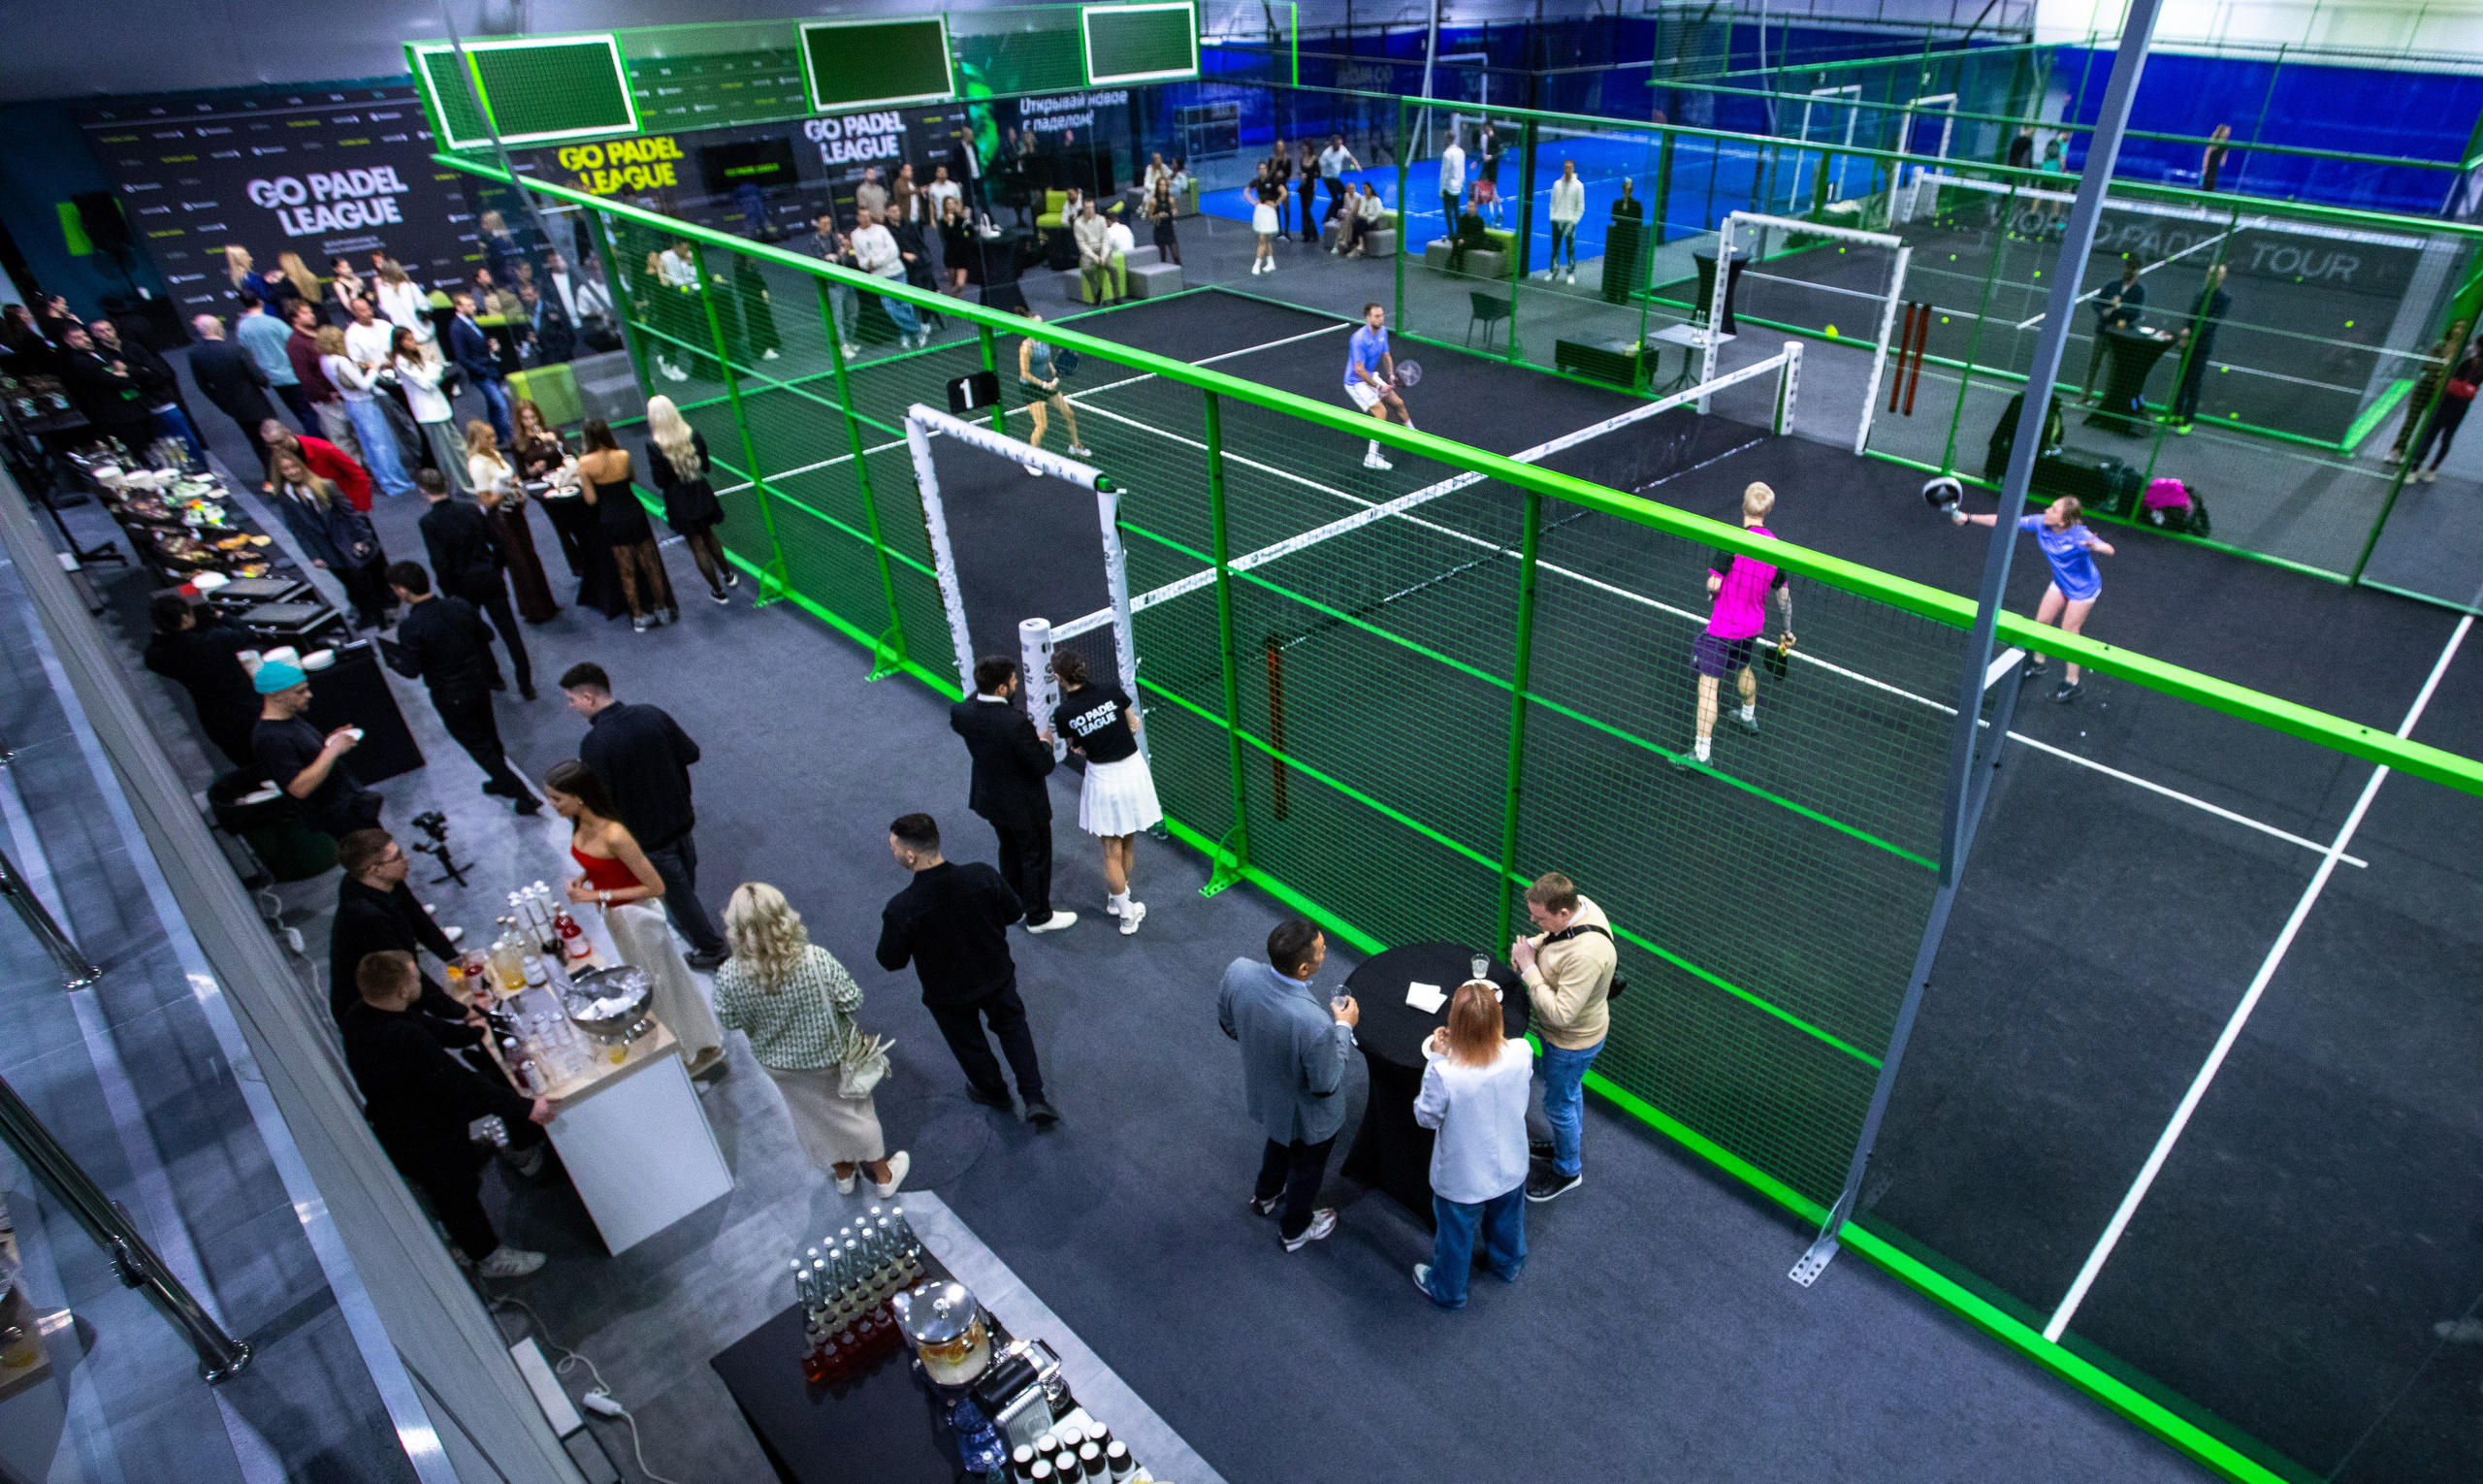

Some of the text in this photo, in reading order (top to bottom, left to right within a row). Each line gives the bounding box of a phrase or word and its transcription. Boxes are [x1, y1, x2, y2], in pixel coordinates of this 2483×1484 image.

[1087, 90, 1129, 107] новое
[803, 110, 908, 143] GO PADEL
[558, 136, 685, 172] GO PADEL
[820, 134, 900, 165] LEAGUE
[246, 164, 410, 210] GO PADEL
[580, 161, 678, 196] LEAGUE
[275, 195, 404, 238] LEAGUE
[1987, 202, 2361, 281] WORD PADE TOUR
[959, 377, 975, 409] 1
[1068, 699, 1118, 730] GO PADEL
[1077, 711, 1117, 737] LEAGUE
